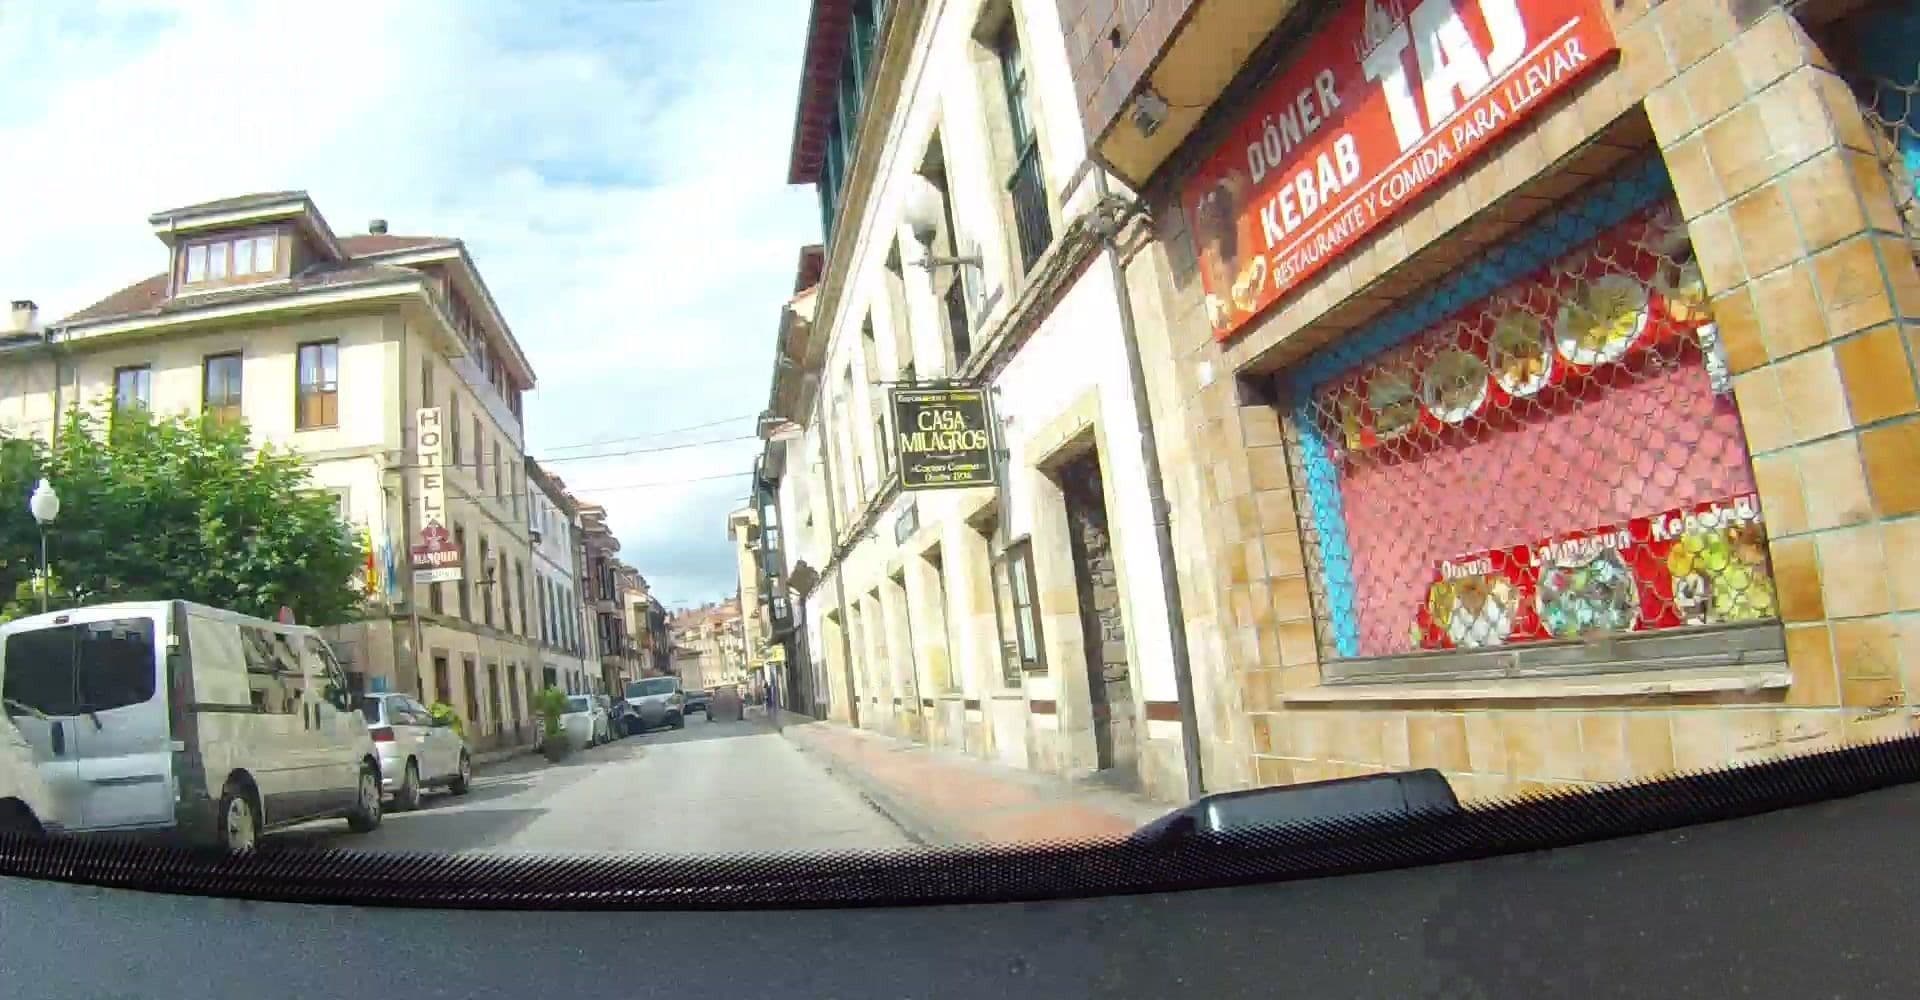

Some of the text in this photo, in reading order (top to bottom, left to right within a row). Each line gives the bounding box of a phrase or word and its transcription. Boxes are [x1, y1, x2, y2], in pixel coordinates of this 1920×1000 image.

[1246, 68, 1342, 184] DÖNER
[1362, 0, 1526, 152] TAJ
[1260, 133, 1361, 249] KEBAB
[1272, 37, 1588, 288] RESTAURANTE Y COMIDA PARA LLEVAR
[420, 411, 441, 512] HOTEL
[900, 430, 988, 453] MILAGROS
[917, 410, 966, 431] CASA
